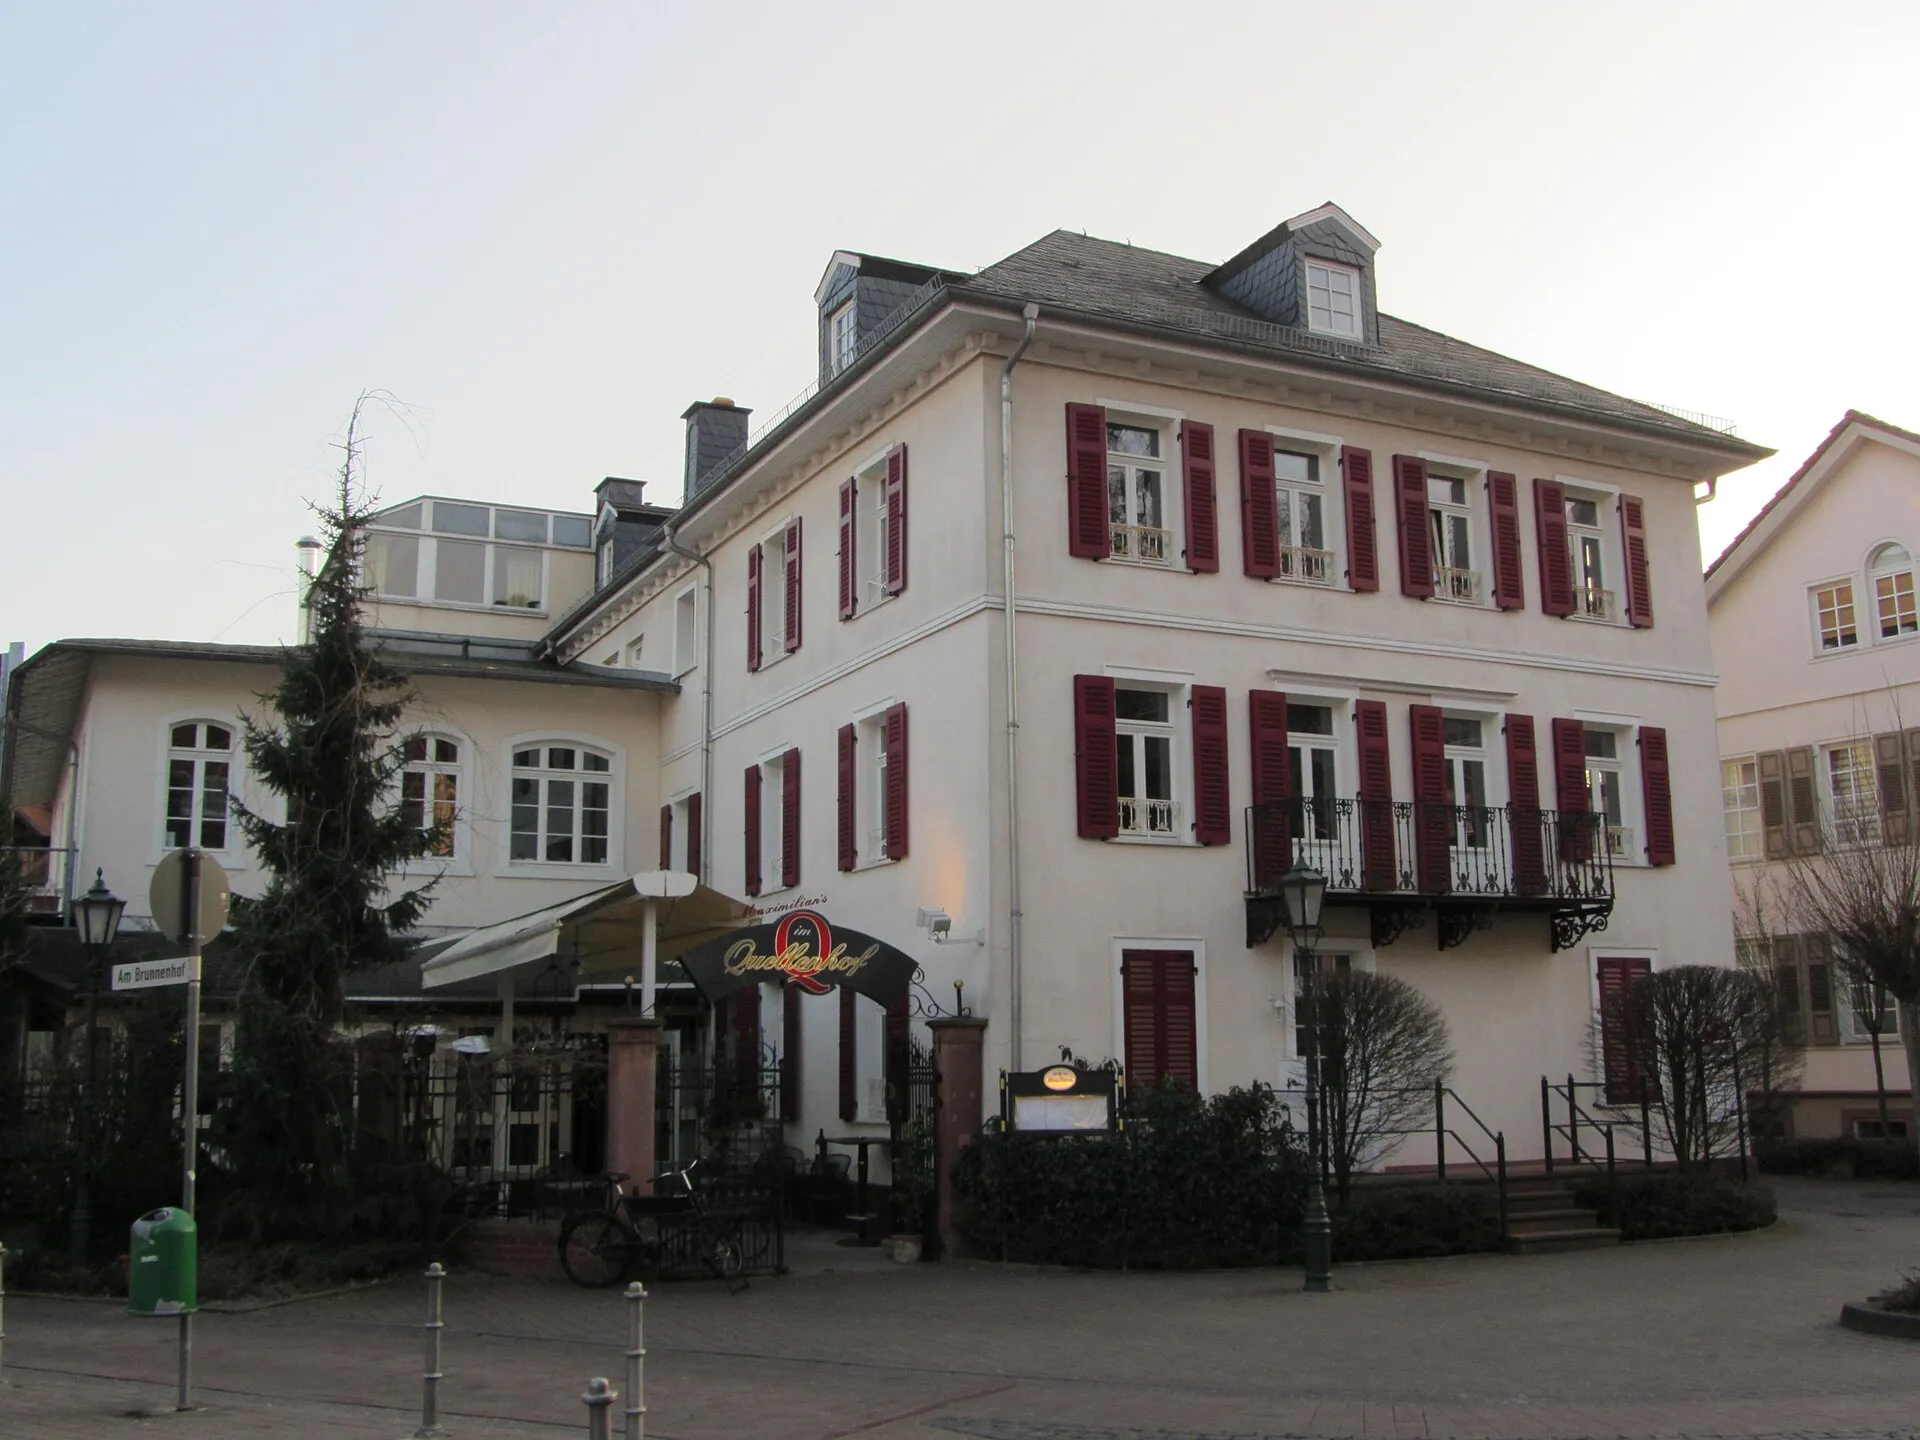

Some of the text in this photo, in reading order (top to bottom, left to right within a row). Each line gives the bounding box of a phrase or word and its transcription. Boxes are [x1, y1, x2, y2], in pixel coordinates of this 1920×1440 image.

[793, 925, 811, 936] im
[723, 938, 880, 977] Quellenhof
[117, 962, 186, 984] Am Brunnenhof
